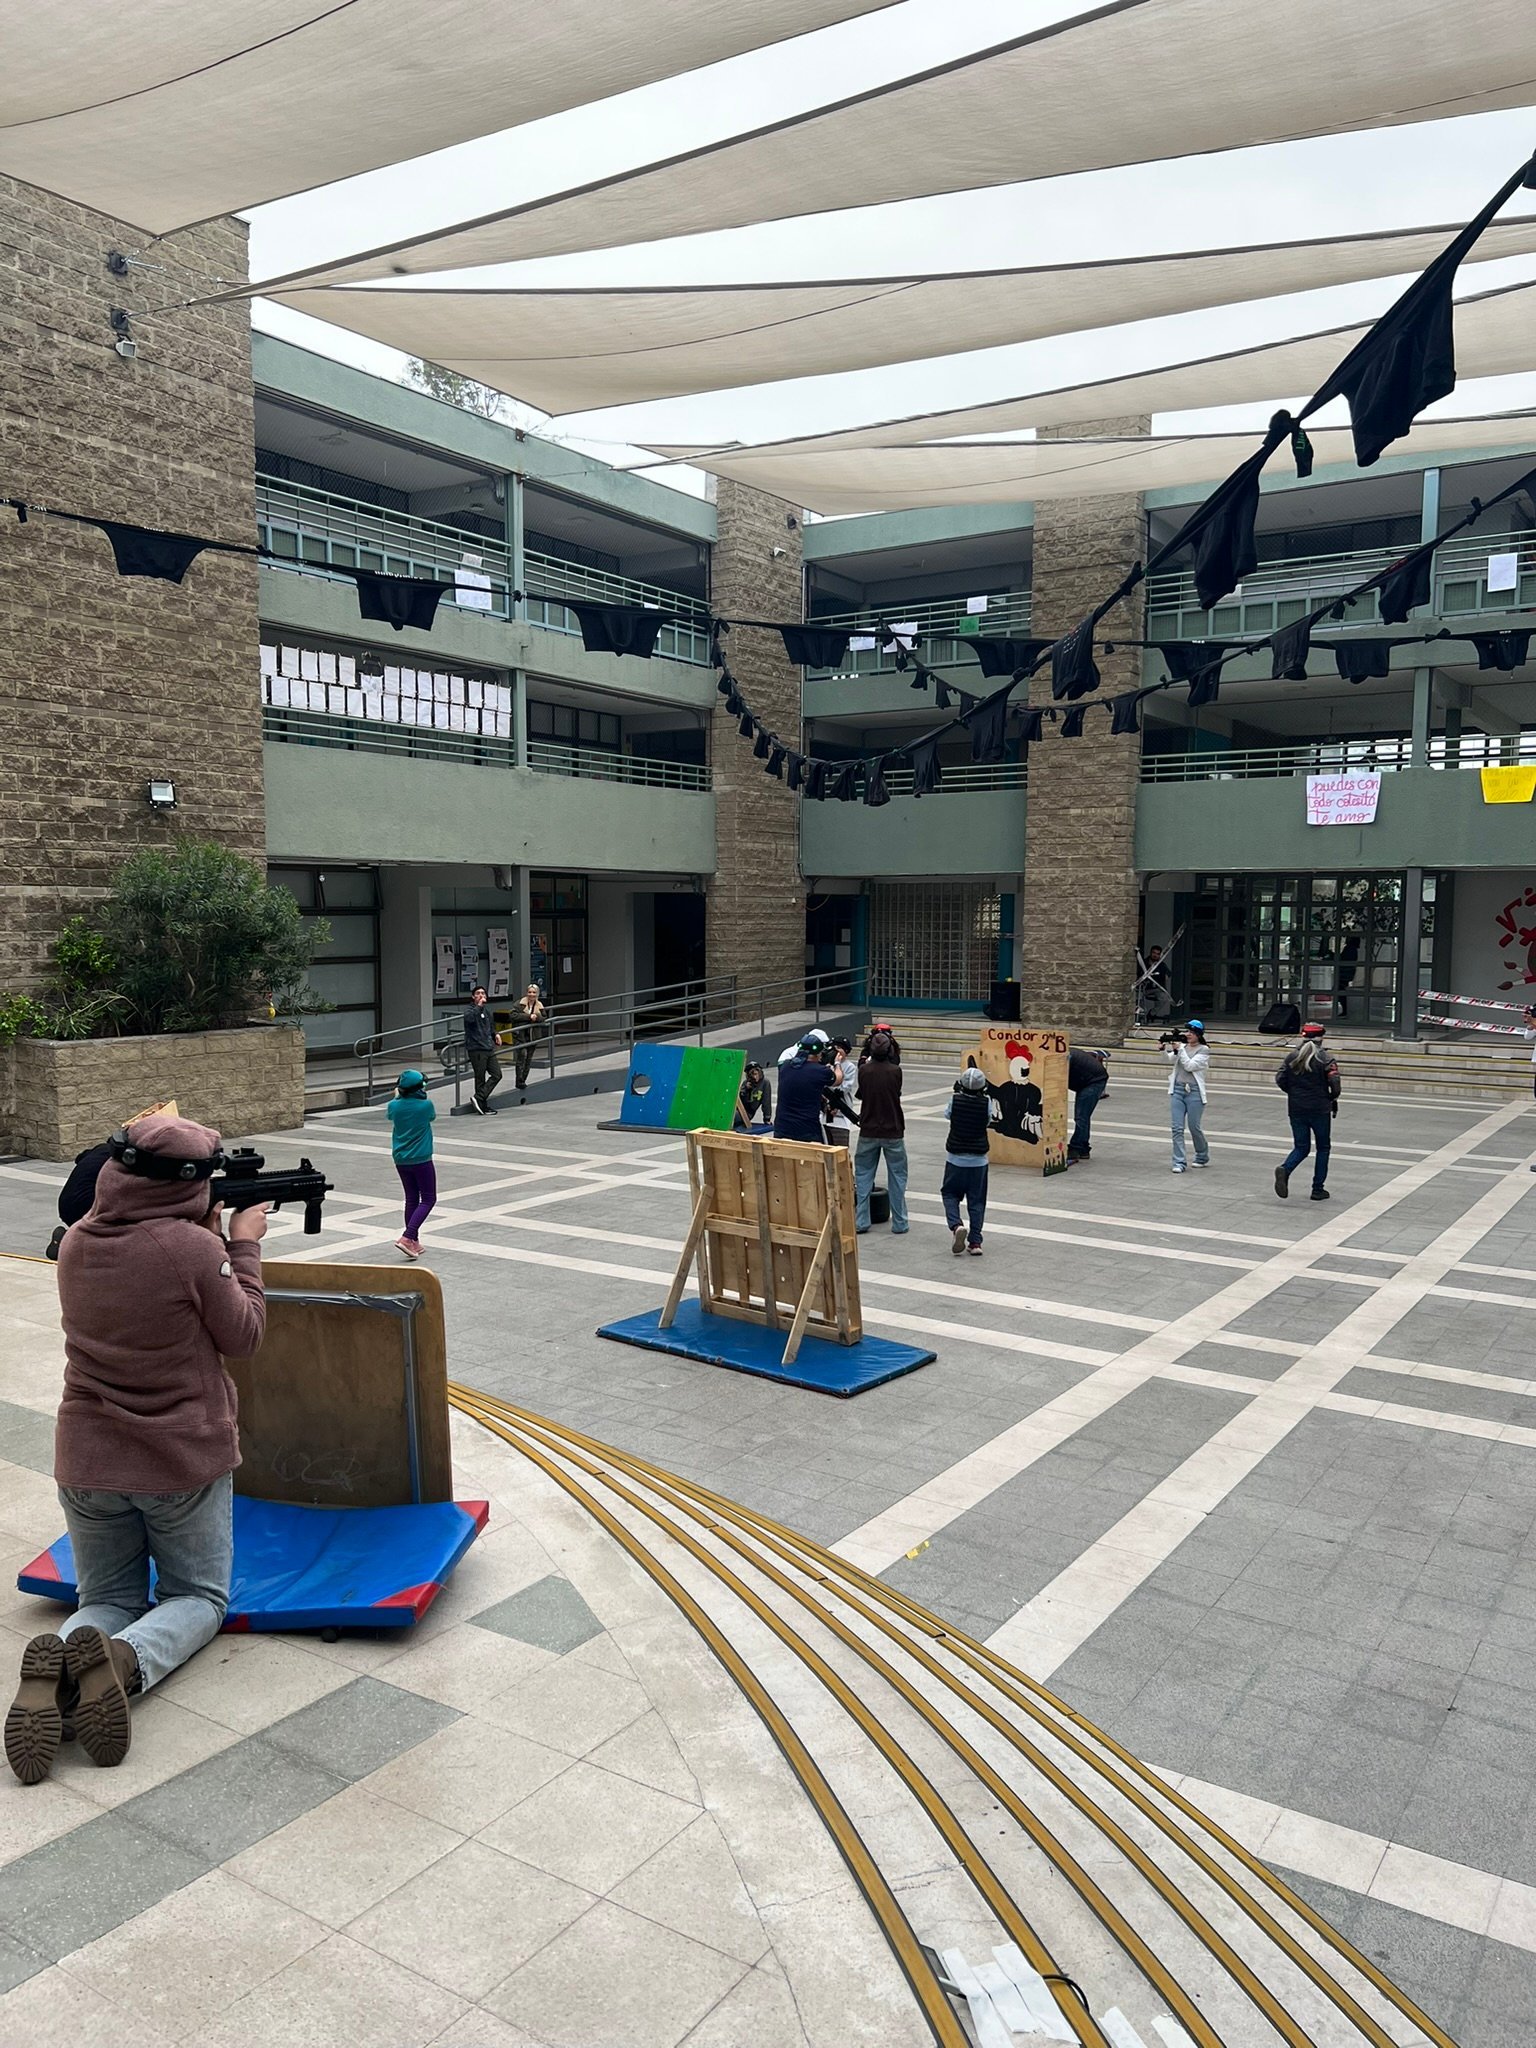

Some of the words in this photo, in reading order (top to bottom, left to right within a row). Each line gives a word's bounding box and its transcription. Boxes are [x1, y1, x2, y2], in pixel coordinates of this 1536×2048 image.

[1311, 775, 1354, 796] puedes
[1357, 779, 1379, 790] con
[1308, 792, 1334, 808] todo
[1335, 812, 1370, 822] amo
[988, 1028, 1038, 1041] Condor
